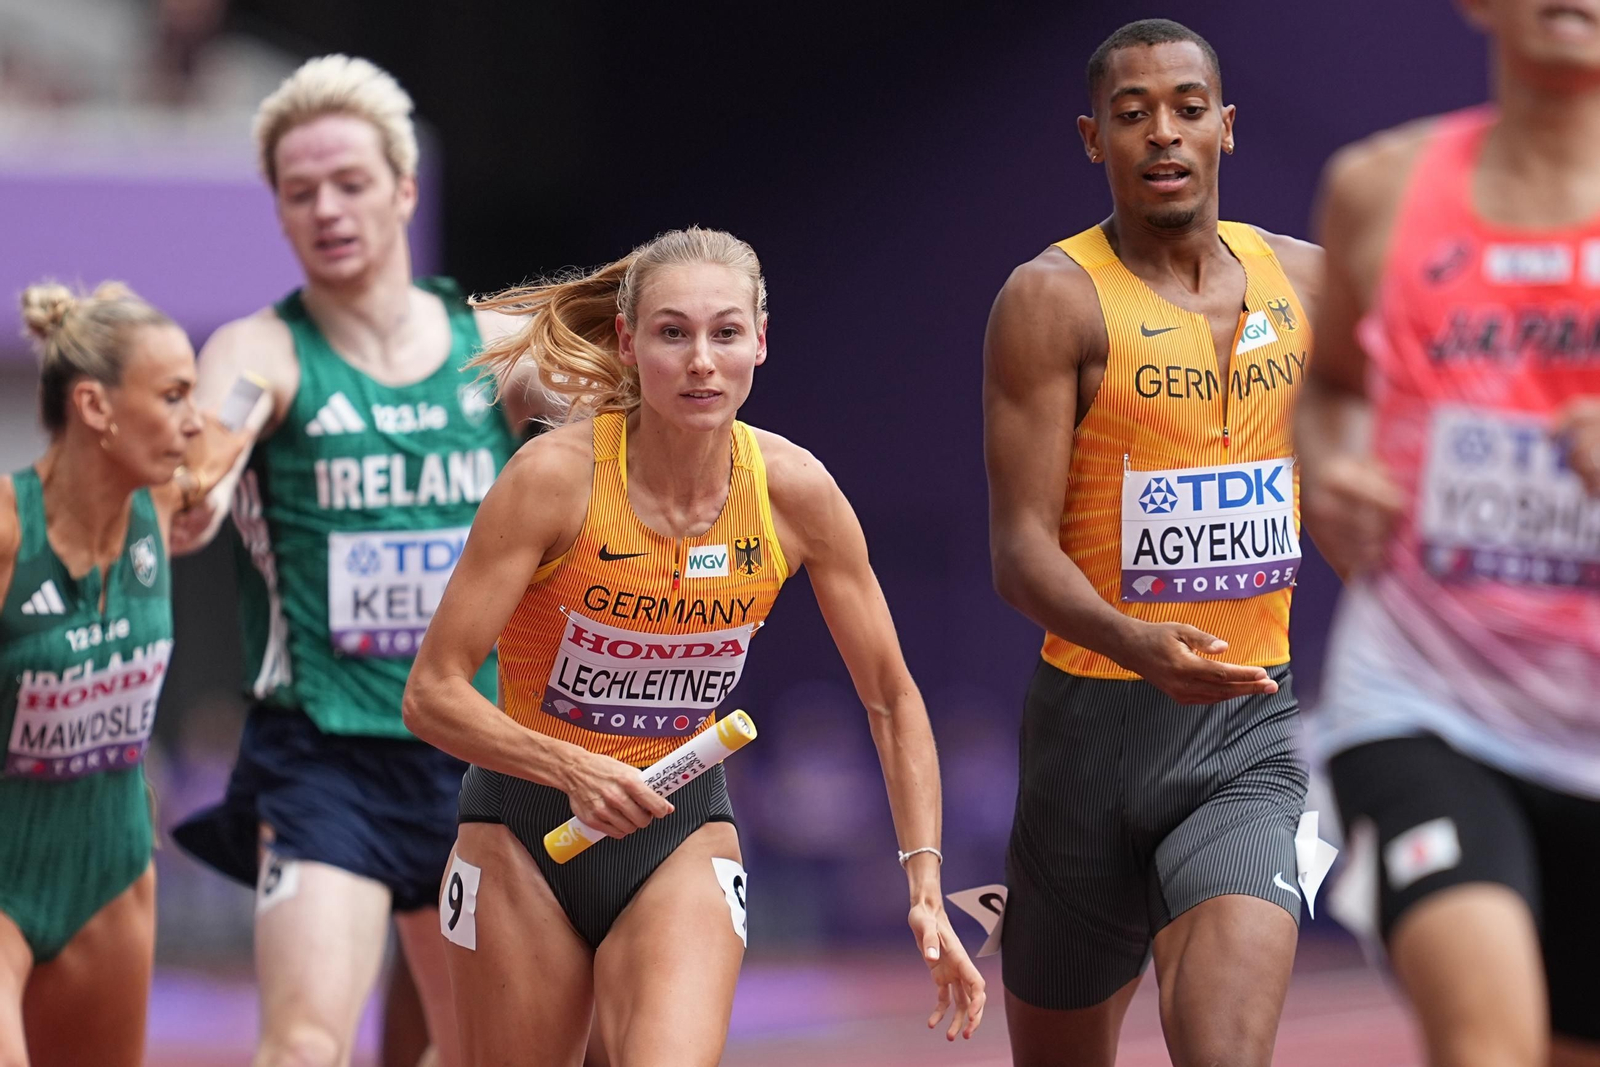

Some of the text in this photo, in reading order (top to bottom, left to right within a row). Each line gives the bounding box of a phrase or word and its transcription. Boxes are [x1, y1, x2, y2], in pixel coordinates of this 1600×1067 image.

[1240, 319, 1267, 343] GV
[1135, 350, 1306, 401] GERMANY
[371, 402, 448, 434] 123.ie
[314, 447, 496, 510] IRELAND
[1177, 465, 1285, 512] TDK
[1133, 516, 1292, 566] AGYEKUM
[688, 552, 727, 570] WGV
[353, 585, 436, 620] KEL
[583, 585, 756, 625] GERMANY
[65, 618, 130, 652] 123.ie
[567, 623, 746, 660] HONDA
[557, 656, 736, 703] LECHLEITNER
[19, 699, 154, 750] MAWDSLE
[591, 712, 707, 731] TOKYO2
[651, 757, 701, 791] AMPIONSHIPS
[662, 750, 697, 776] ATHLETICS
[448, 872, 464, 931] 9
